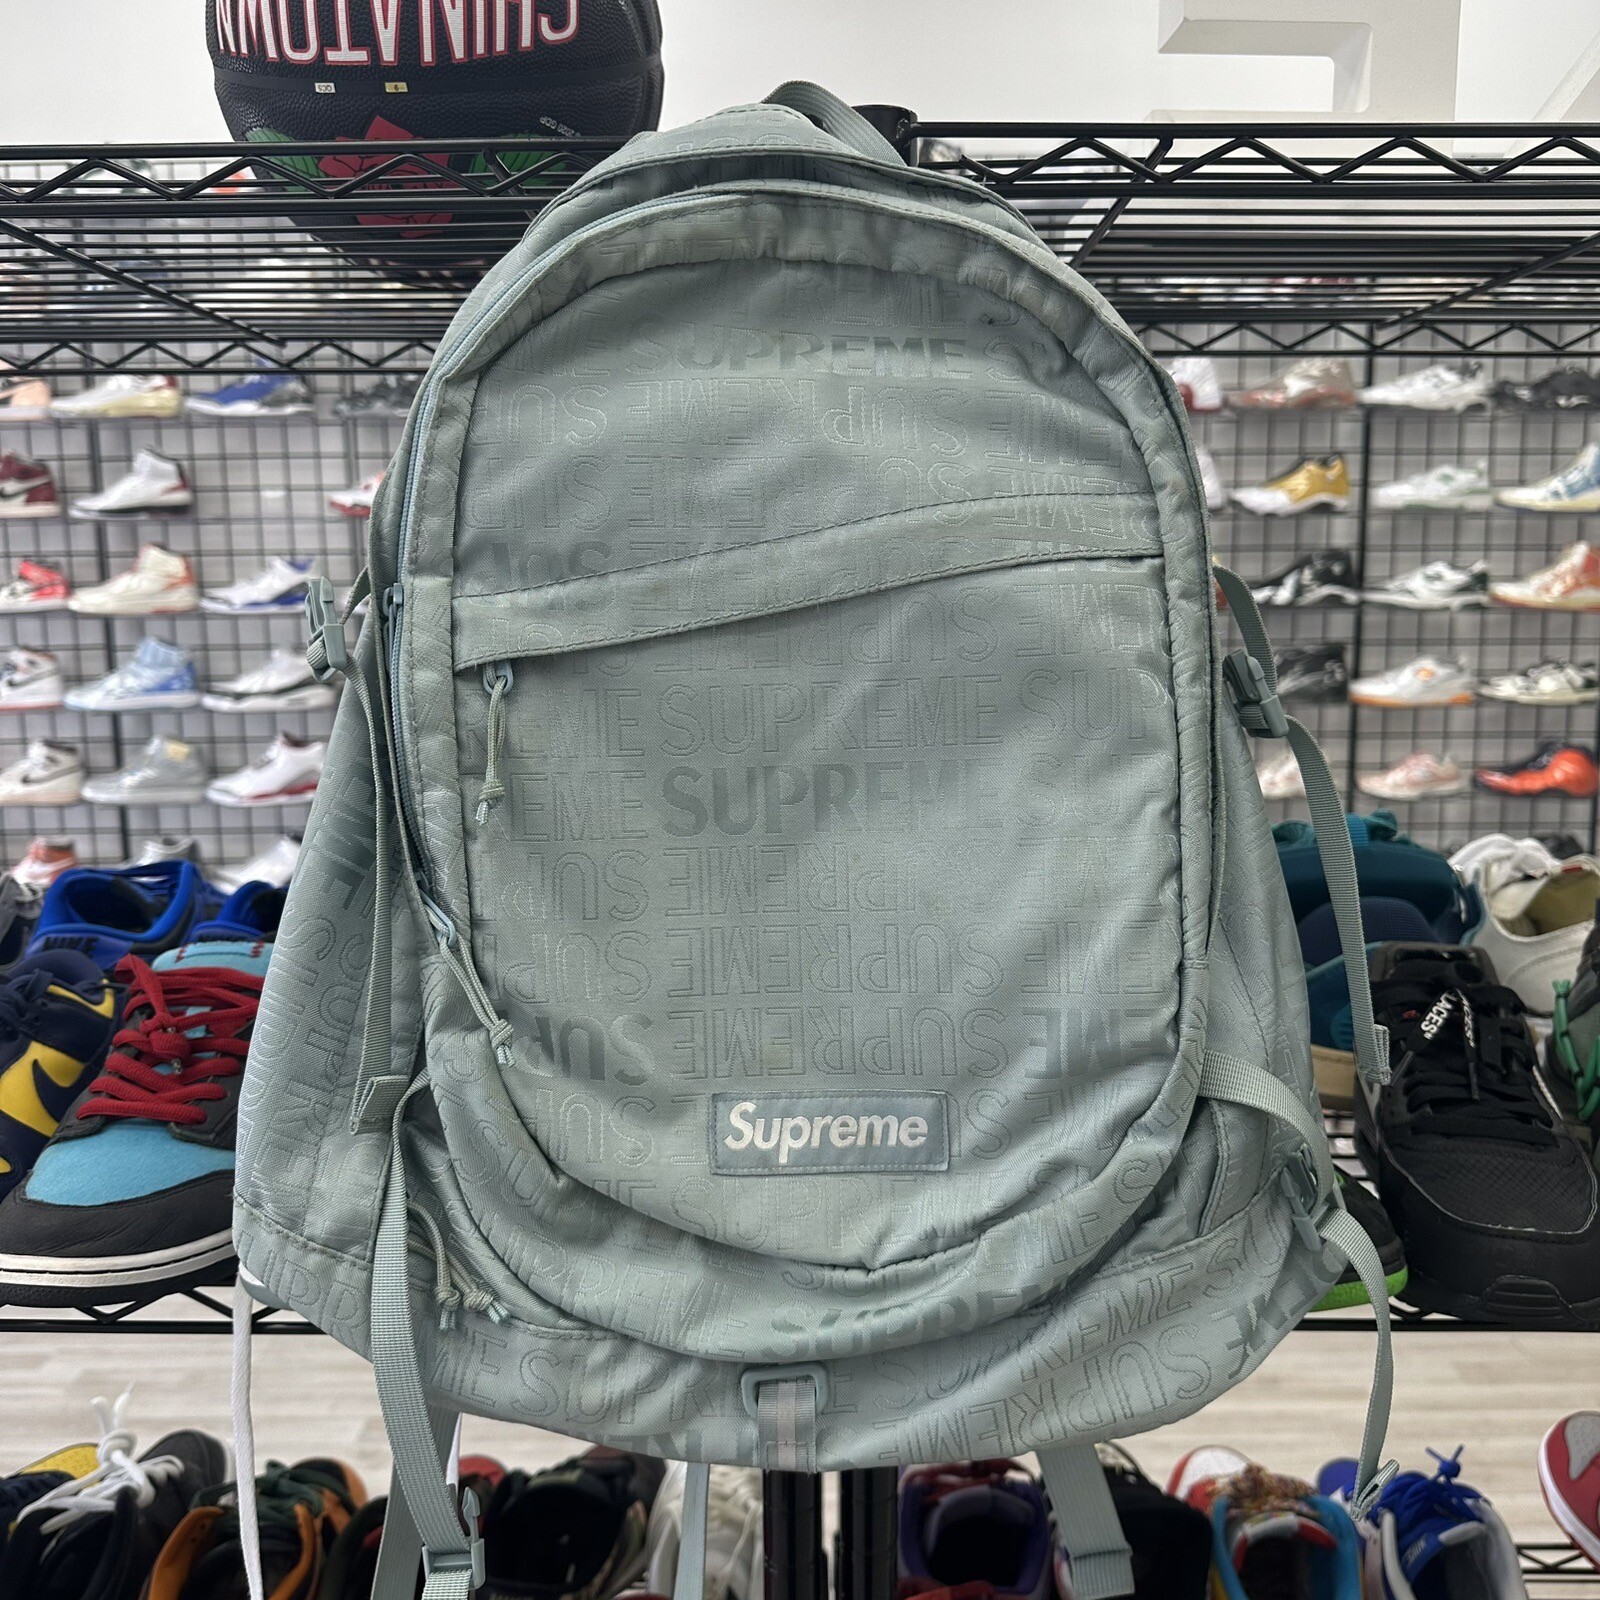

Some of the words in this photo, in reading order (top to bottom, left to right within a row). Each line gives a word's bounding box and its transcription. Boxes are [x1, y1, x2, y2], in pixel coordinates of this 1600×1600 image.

[625, 322, 973, 380] SUPREME
[623, 378, 970, 458] SUPREME
[657, 673, 1003, 757] SUPREME
[661, 757, 1004, 838] SUPREME
[663, 843, 1000, 916] SUPREME
[666, 924, 1004, 999] SUPREME
[667, 1007, 1009, 1080] SUPREME
[723, 1101, 929, 1166] Supreme
